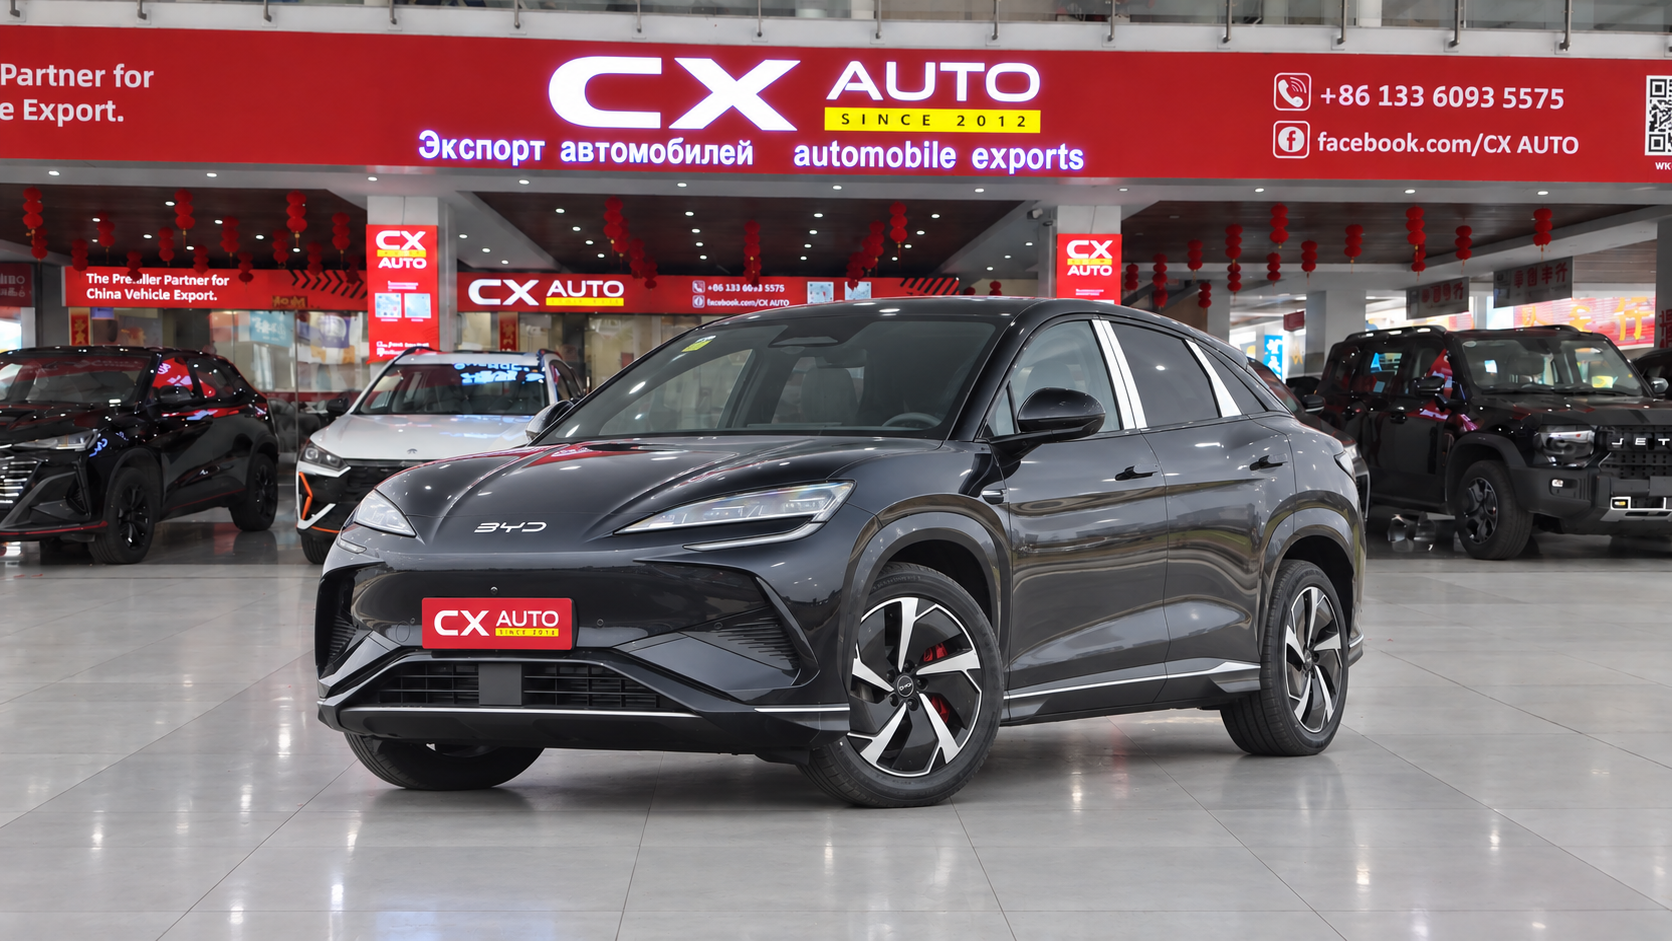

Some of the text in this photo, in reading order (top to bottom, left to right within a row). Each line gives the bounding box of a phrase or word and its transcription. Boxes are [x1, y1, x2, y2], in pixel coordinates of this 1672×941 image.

[1, 63, 154, 88] Partner for
[549, 56, 1041, 131] CX AUTO
[1321, 84, 1564, 109] +86 133 6093 5575
[23, 99, 124, 127] Export.
[841, 113, 1027, 128] SINCE 2012
[418, 129, 755, 167] Экспорт автомобилей
[1318, 131, 1580, 157] facebook.com/CX AUTO
[793, 140, 1086, 174] automobile exports
[375, 230, 426, 250] CX
[1066, 240, 1113, 259] CX
[378, 257, 427, 269] AUTO
[1067, 265, 1113, 276] AUTO
[86, 273, 110, 284] The
[164, 275, 210, 286] Partner
[211, 275, 230, 286] for
[764, 284, 785, 292] 5575
[86, 288, 218, 303] China Vehicle Export.
[468, 279, 625, 306] CX AUTO
[769, 299, 790, 307] AUTO
[474, 521, 547, 533] BYD
[434, 610, 559, 636] CX AUTO
